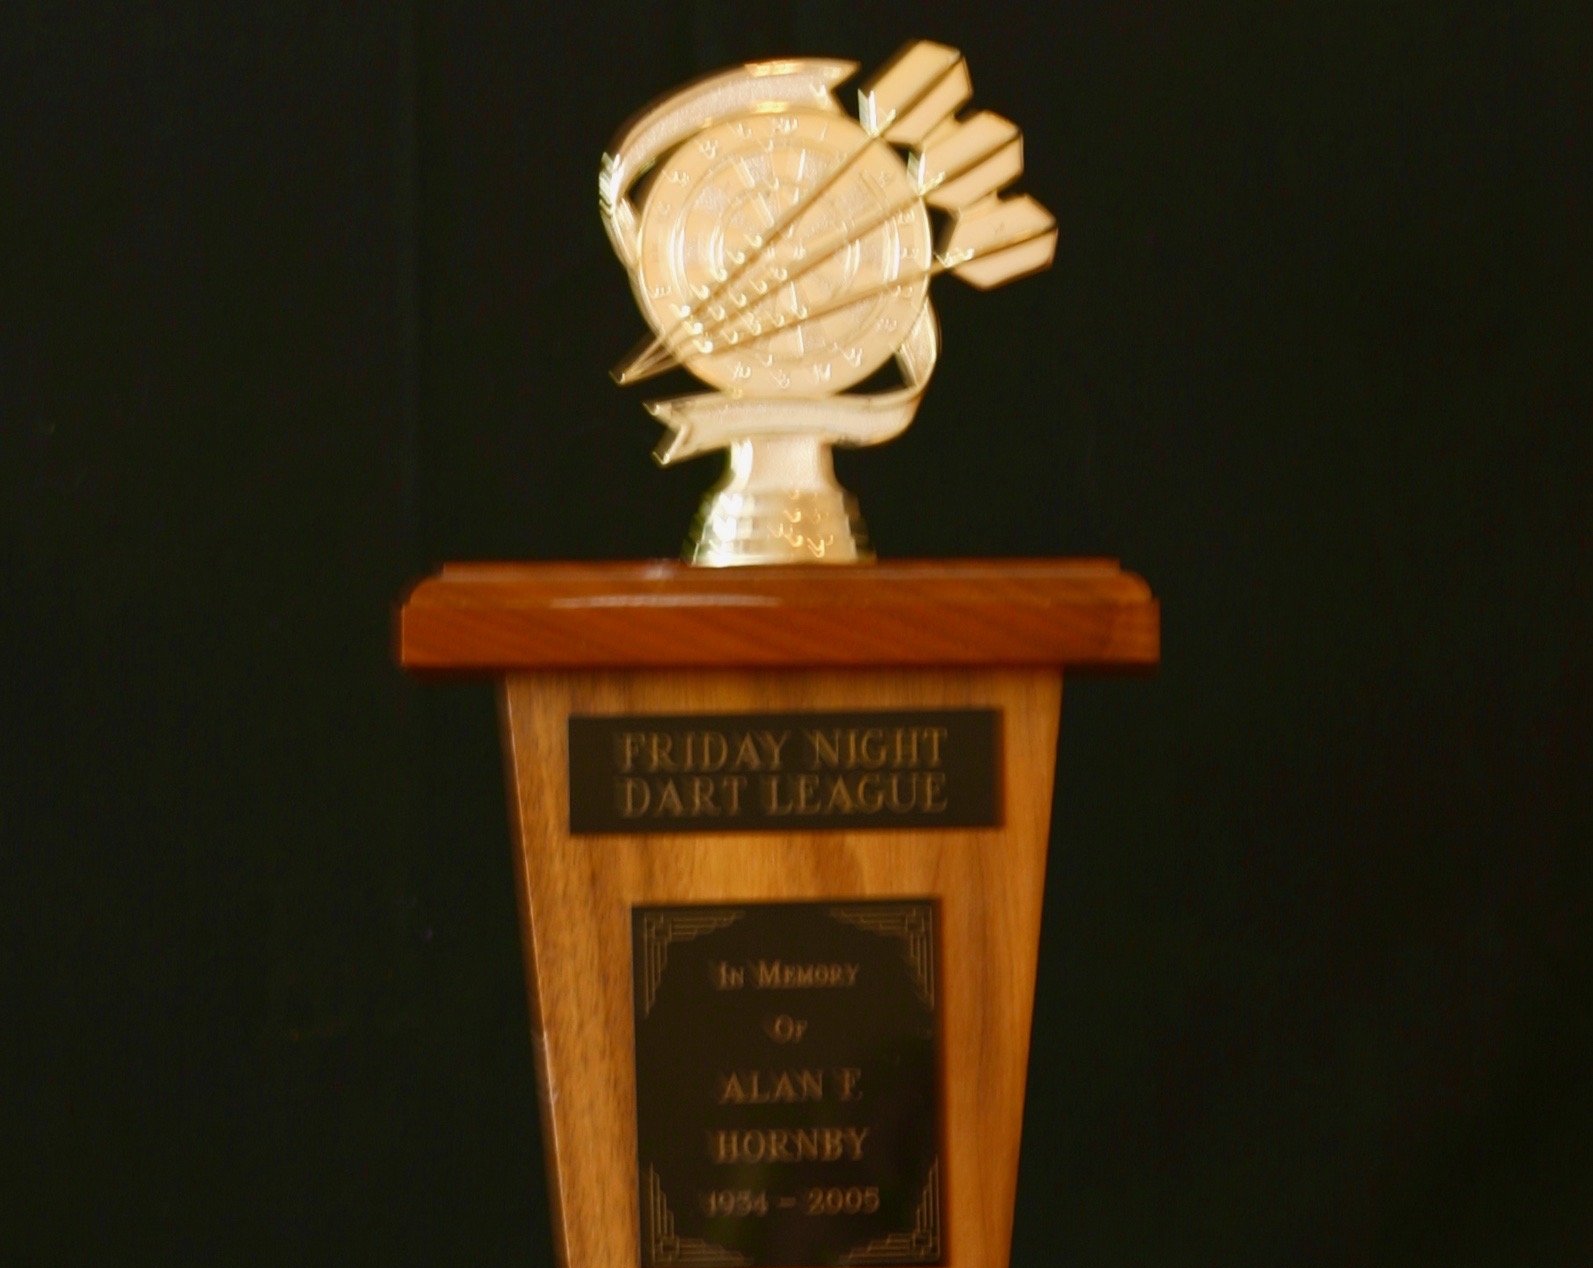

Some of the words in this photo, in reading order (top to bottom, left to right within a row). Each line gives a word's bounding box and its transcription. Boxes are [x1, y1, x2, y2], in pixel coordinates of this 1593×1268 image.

[620, 730, 790, 773] FRIDAY
[808, 726, 949, 770] NIGHT
[620, 775, 746, 818] DART
[762, 772, 949, 816] LEAGUE
[719, 1068, 823, 1103] ALAN
[716, 1127, 870, 1163] HORNBY
[805, 1186, 880, 1215] 2005
